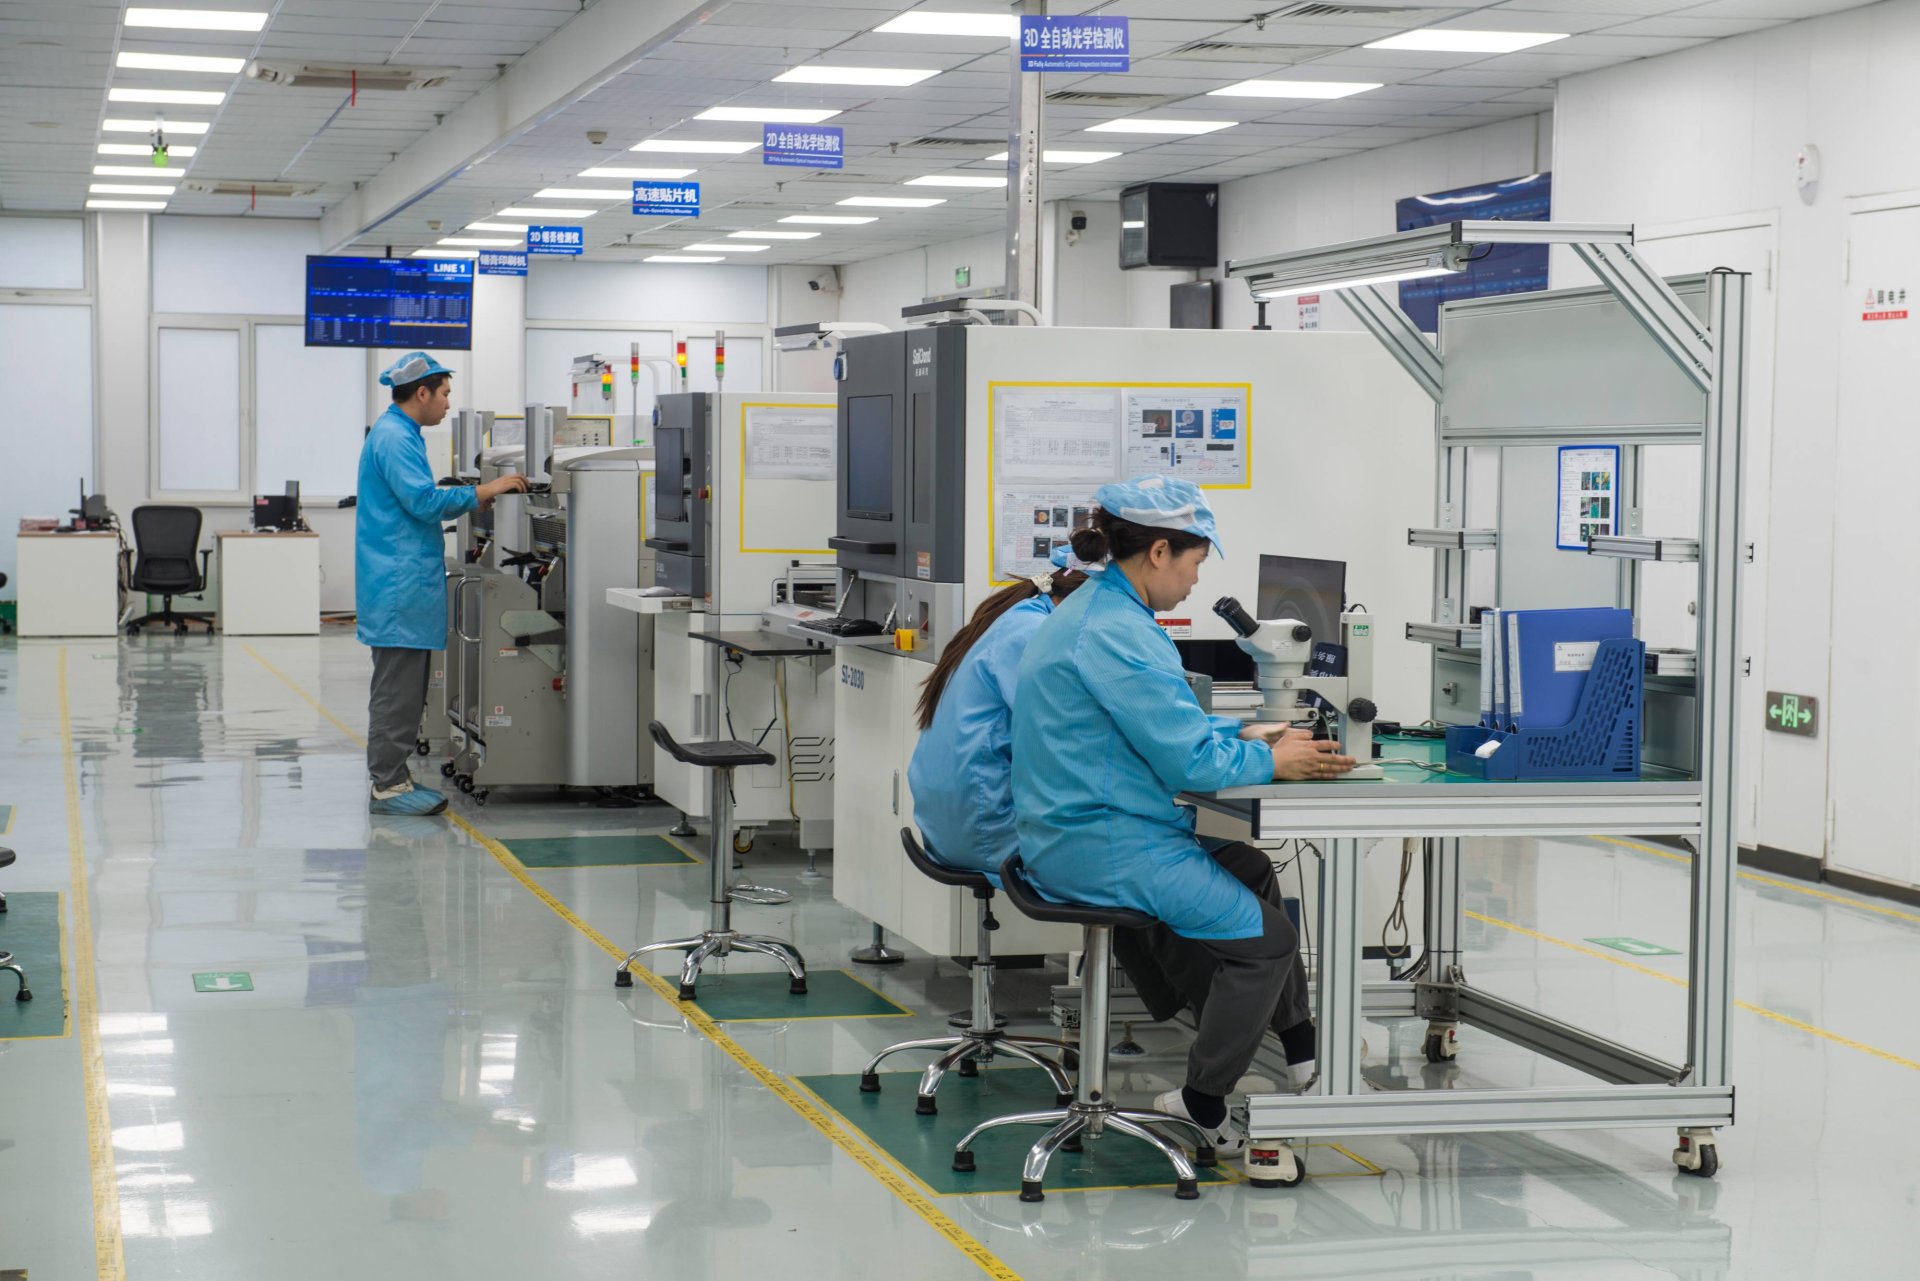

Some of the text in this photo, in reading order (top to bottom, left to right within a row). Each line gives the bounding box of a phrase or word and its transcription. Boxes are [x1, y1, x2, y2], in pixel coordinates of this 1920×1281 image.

[1024, 26, 1125, 49] 3D 全自动光学检测仪
[766, 132, 840, 152] 2D 全自动光学检测仪
[634, 187, 698, 203] 高速贴片机
[529, 231, 541, 242] 3D
[433, 263, 458, 273] LINE
[459, 264, 466, 273] 1
